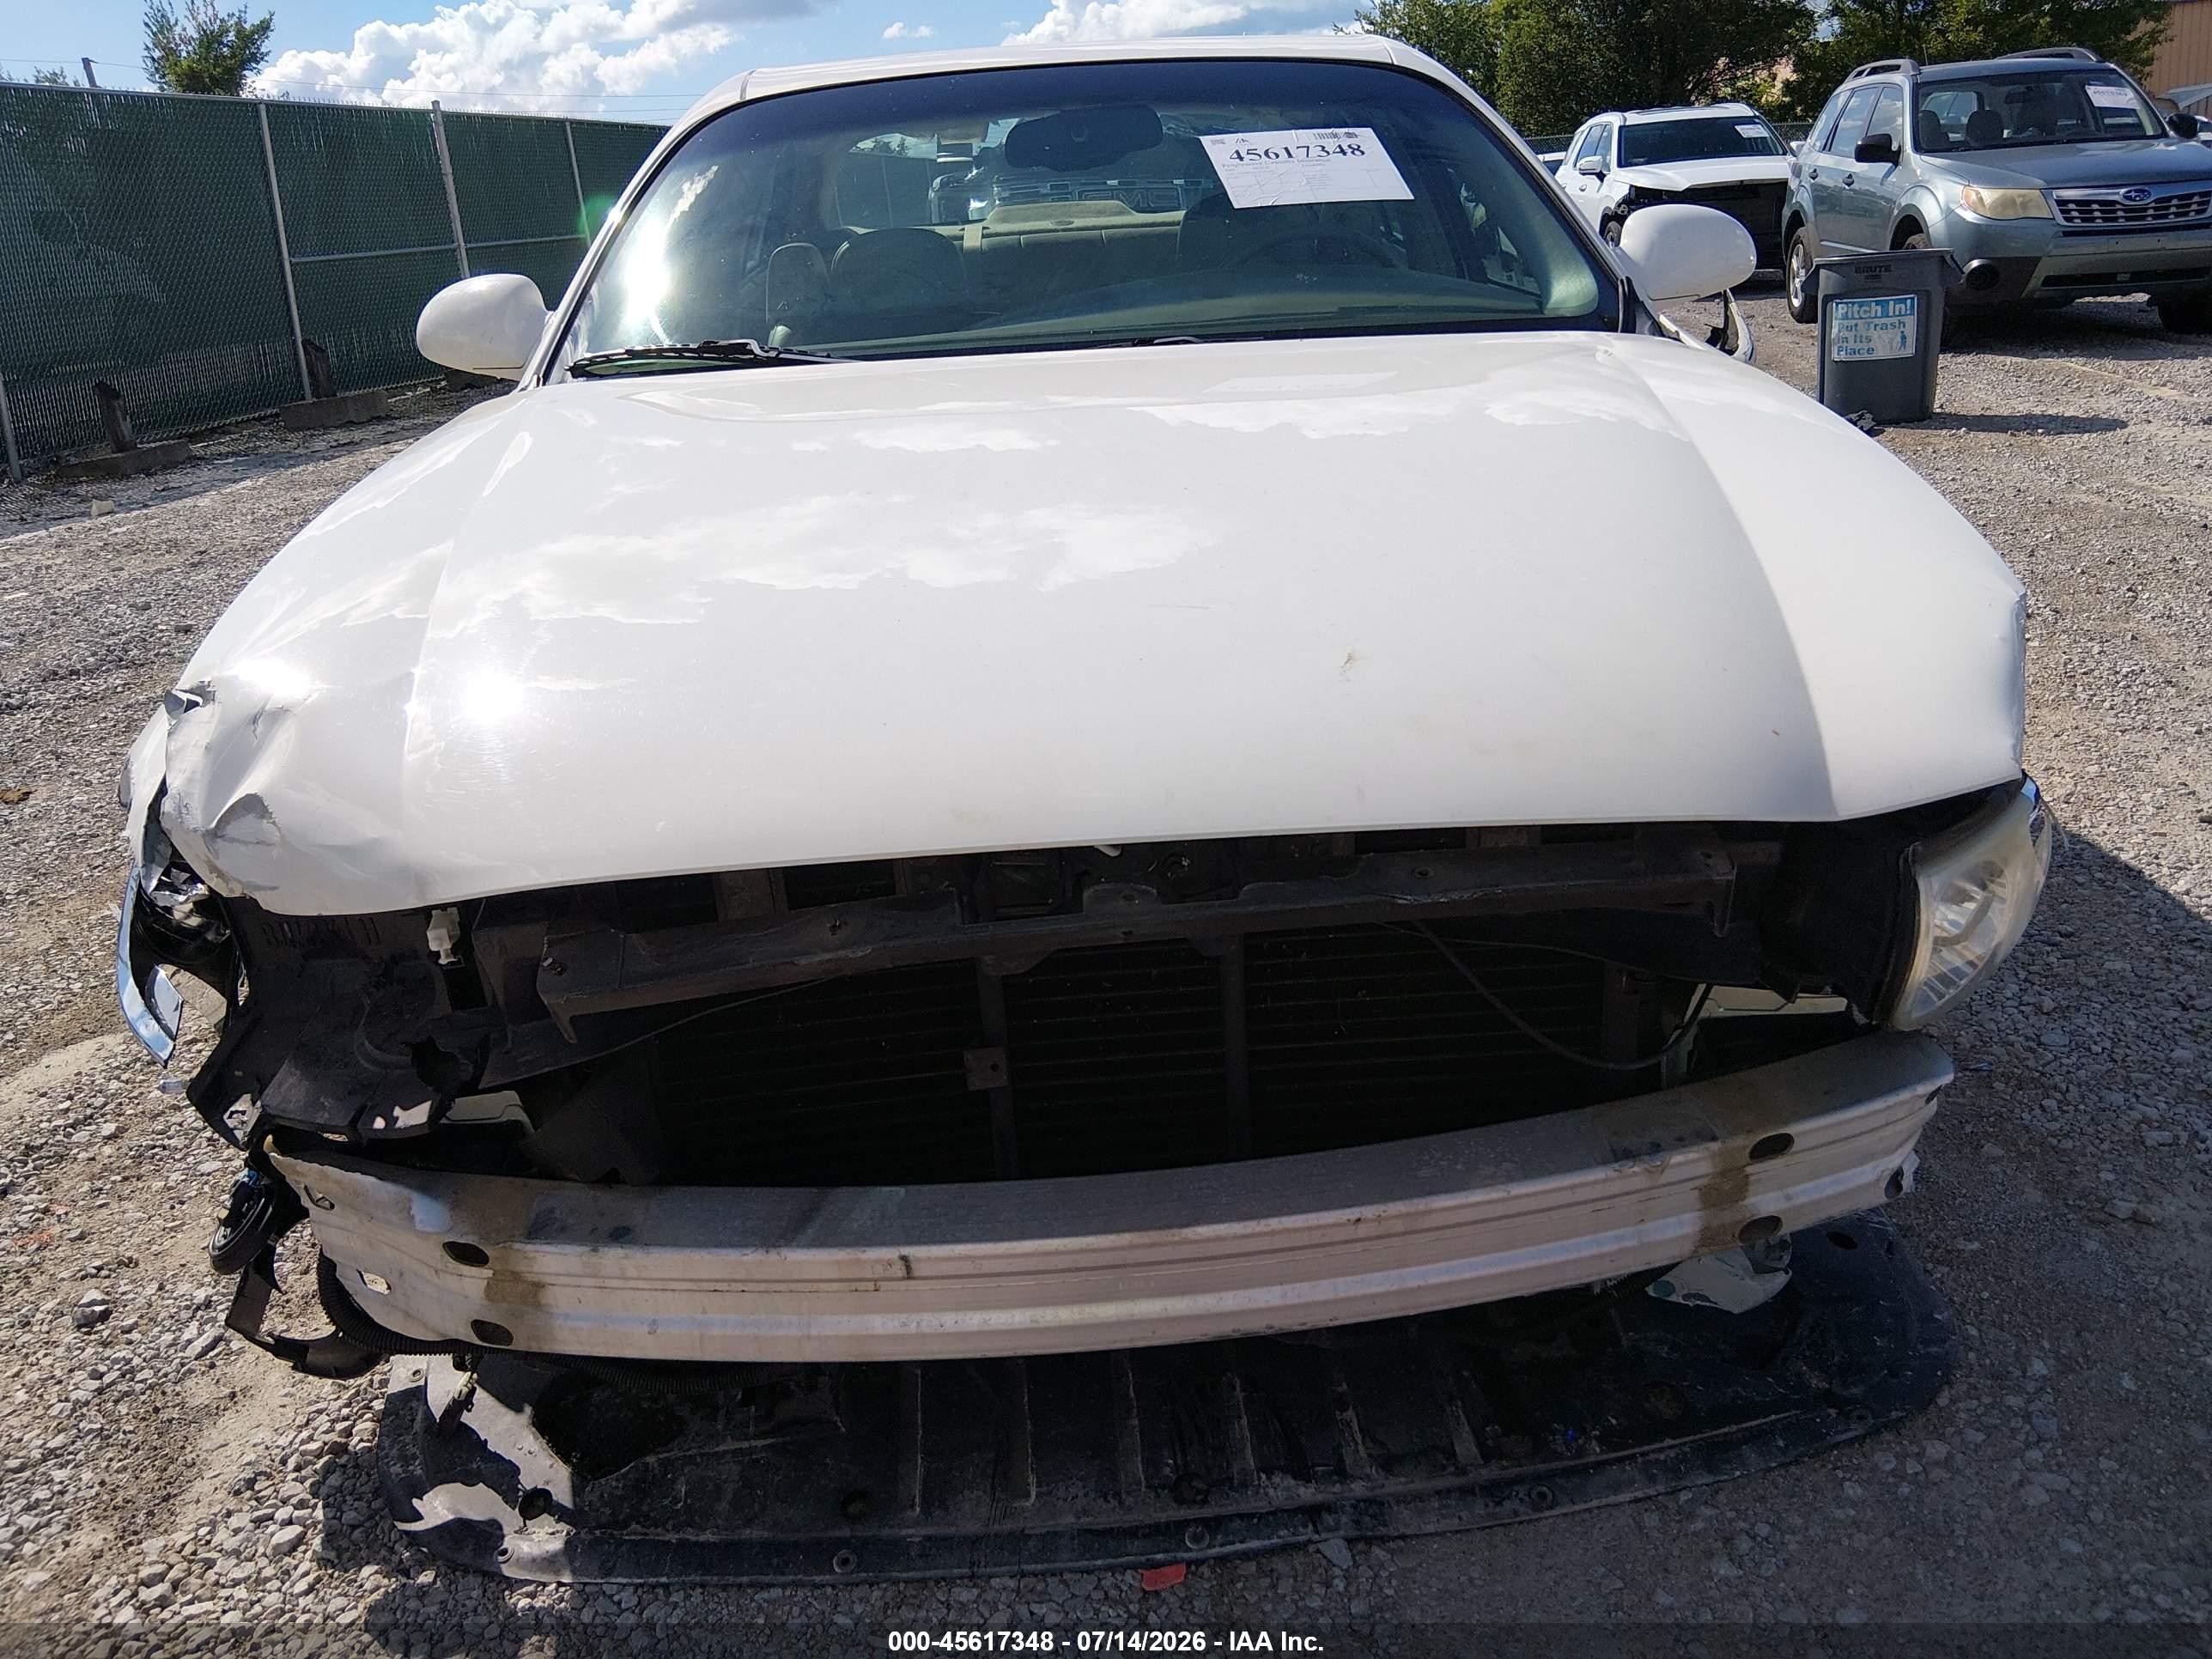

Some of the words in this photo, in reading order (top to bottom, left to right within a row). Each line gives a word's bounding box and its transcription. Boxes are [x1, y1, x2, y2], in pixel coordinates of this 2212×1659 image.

[1229, 143, 1365, 162] 45617348
[1837, 301, 1882, 319] Pitch
[1888, 299, 1911, 315] In!
[1838, 322, 1858, 333] Put
[1865, 319, 1905, 331] Trash
[1836, 345, 1875, 356] Place
